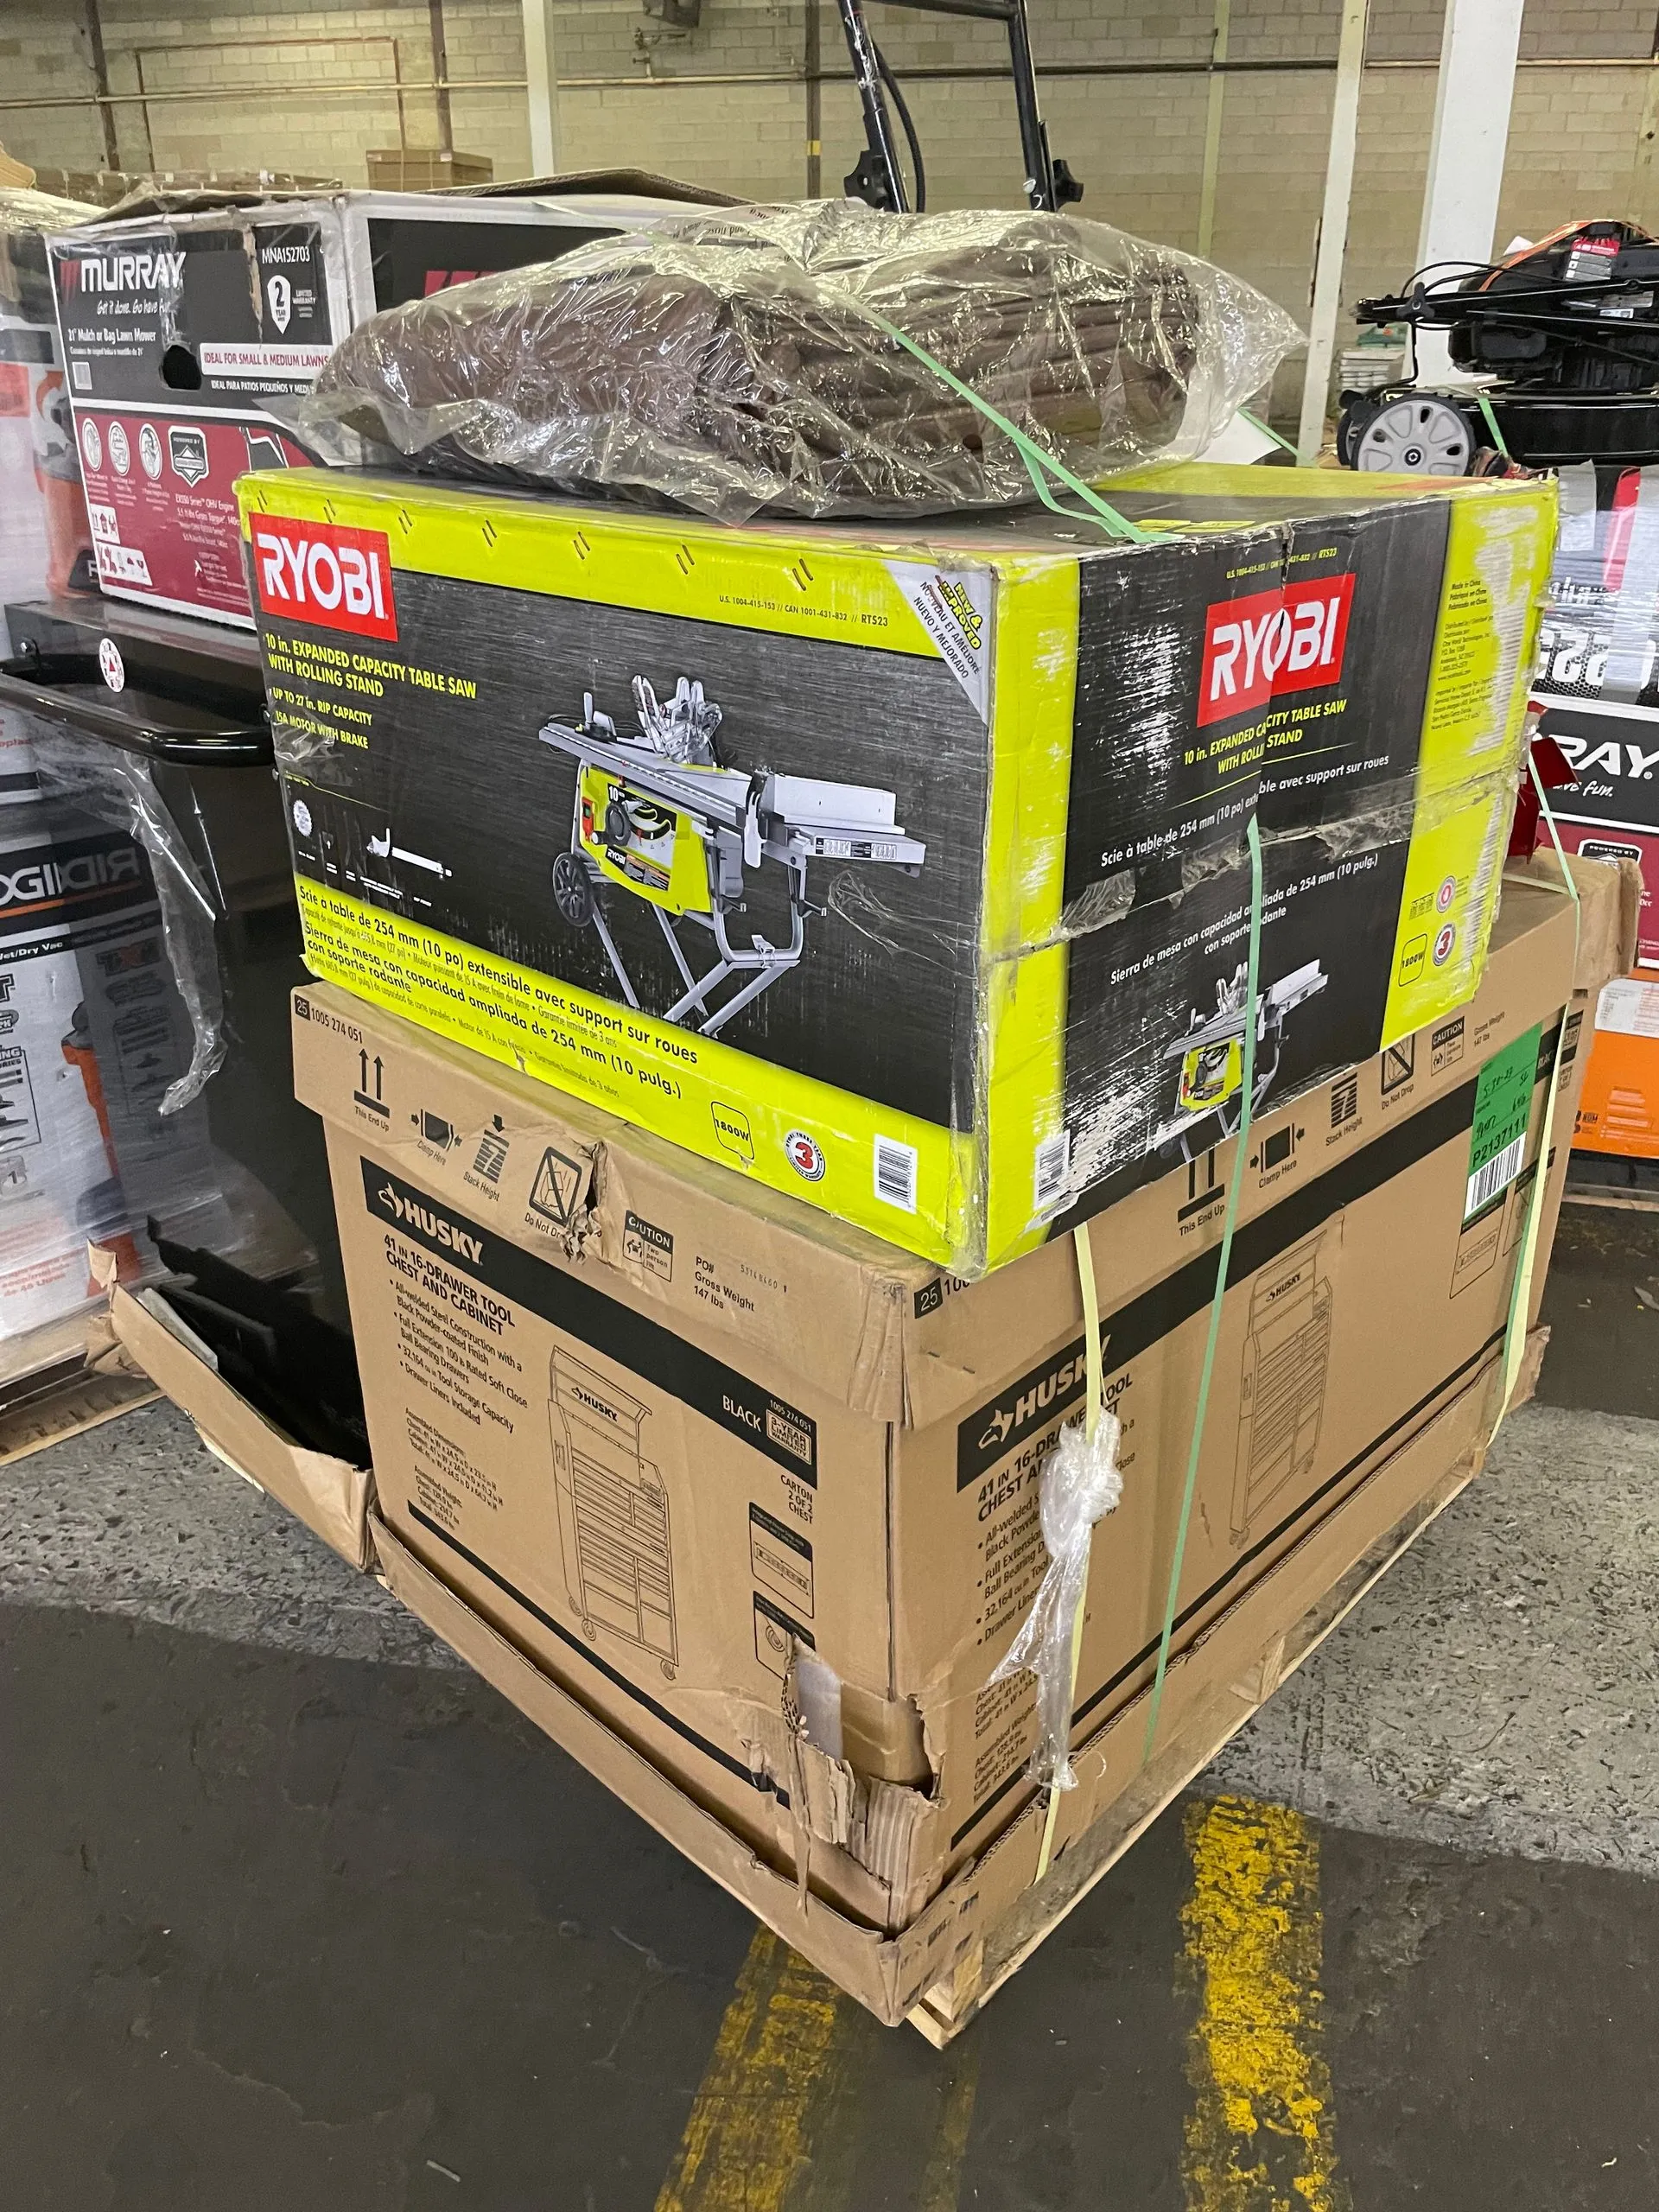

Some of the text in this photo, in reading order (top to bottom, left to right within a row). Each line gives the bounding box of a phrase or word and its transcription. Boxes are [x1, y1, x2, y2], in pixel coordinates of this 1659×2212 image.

[81, 251, 187, 292] MURRAY
[262, 246, 310, 264] MNA152703
[275, 281, 284, 308] 2
[78, 327, 156, 344] Mulch Bag Lawn Mower
[204, 353, 329, 368] IDEAL FOR SMALL & MEDIUM LAWNS
[211, 379, 289, 394] IDEAL PARA PATIOS PEQUEÑOS
[257, 532, 385, 620] RYOBI
[719, 594, 889, 627] U.S. 1004-415-153 CAN 1001-431-832 RTS23
[938, 580, 982, 650] IMPROVED
[954, 582, 976, 615] NEW
[913, 596, 969, 679] NUEVO MEJORADO
[944, 621, 956, 632] ET
[1211, 596, 1341, 702] RYOBI
[265, 633, 476, 700] 10 EXPANDED CAPACITY TABLE SAW
[268, 653, 384, 697] WITH ROLLING STAND
[284, 690, 372, 726] TO RIP CAPACITY
[340, 730, 369, 749] BRAKE
[1184, 698, 1348, 766] 10 EXPANDED TABLE SAW
[1217, 728, 1303, 774] WITH STAND
[1583, 780, 1614, 797] fun.
[1101, 755, 1389, 868] Scie table 254 avec support sur roues
[1110, 852, 1379, 986] Sierra mesa con capacidad 254 (10 pulg.)
[42, 942, 63, 950] Vac
[1205, 924, 1251, 956] con soporte
[1438, 931, 1451, 956] 3
[299, 886, 698, 1065] Scie table 254 (10 po) extensible avec support sur roues
[308, 939, 325, 955] con
[327, 948, 365, 973] soporte
[369, 965, 411, 993] rodante
[296, 997, 363, 1044] 25 1005 274 051
[306, 921, 334, 946] Sierra
[352, 946, 380, 966] mesa
[384, 957, 403, 976] con
[406, 969, 465, 1002] capacidad
[468, 995, 527, 1030] ampliada
[551, 1028, 576, 1052] 254
[611, 1054, 633, 1076] (10
[638, 1069, 682, 1100] pulg.)
[1473, 1011, 1505, 1036] Gross Weight
[1433, 1020, 1463, 1046] CAUTION
[354, 1106, 391, 1133] This End Up
[714, 1117, 751, 1143] 1800W
[1325, 1116, 1363, 1147] Stack Height
[795, 1141, 814, 1170] 3
[1471, 1112, 1527, 1168] P2137111
[463, 1171, 500, 1202] Stack Height
[1258, 1159, 1298, 1189] Clamp Here
[404, 1197, 484, 1267] HUSKY
[524, 1211, 550, 1235] Do Not
[1179, 1203, 1226, 1236] This End Up
[384, 1234, 516, 1328] 41 16-DRAWER TOOL
[386, 1249, 505, 1337] CHEST AND CABINET
[694, 1271, 754, 1313] Gross Weight
[694, 1285, 725, 1310] 147 lbs
[1275, 1272, 1301, 1297] HUSKY
[920, 1286, 939, 1312] 25
[395, 1281, 516, 1370] All-welded Steel Construction with
[397, 1294, 490, 1367] Black Powder-coated Finish
[411, 1319, 529, 1409] Extension Rated Soft Close
[414, 1335, 470, 1384] Bearing Drawers
[429, 1381, 481, 1427] Liners Included
[436, 1368, 515, 1434] Tool Storage Capacity
[583, 1393, 618, 1422] HUSKY
[721, 1394, 762, 1433] BLACK
[771, 1416, 807, 1446] 3-YEAR
[780, 1474, 813, 1503] CARTON
[977, 1474, 1025, 1522] CHEST
[978, 1469, 1009, 1503] 41 IN
[788, 1502, 814, 1525] CHEST
[985, 1498, 1033, 1547] All-welded
[985, 1537, 1009, 1562] Black
[984, 1552, 1036, 1600] Ball Bearing
[985, 1562, 1001, 1584] Full
